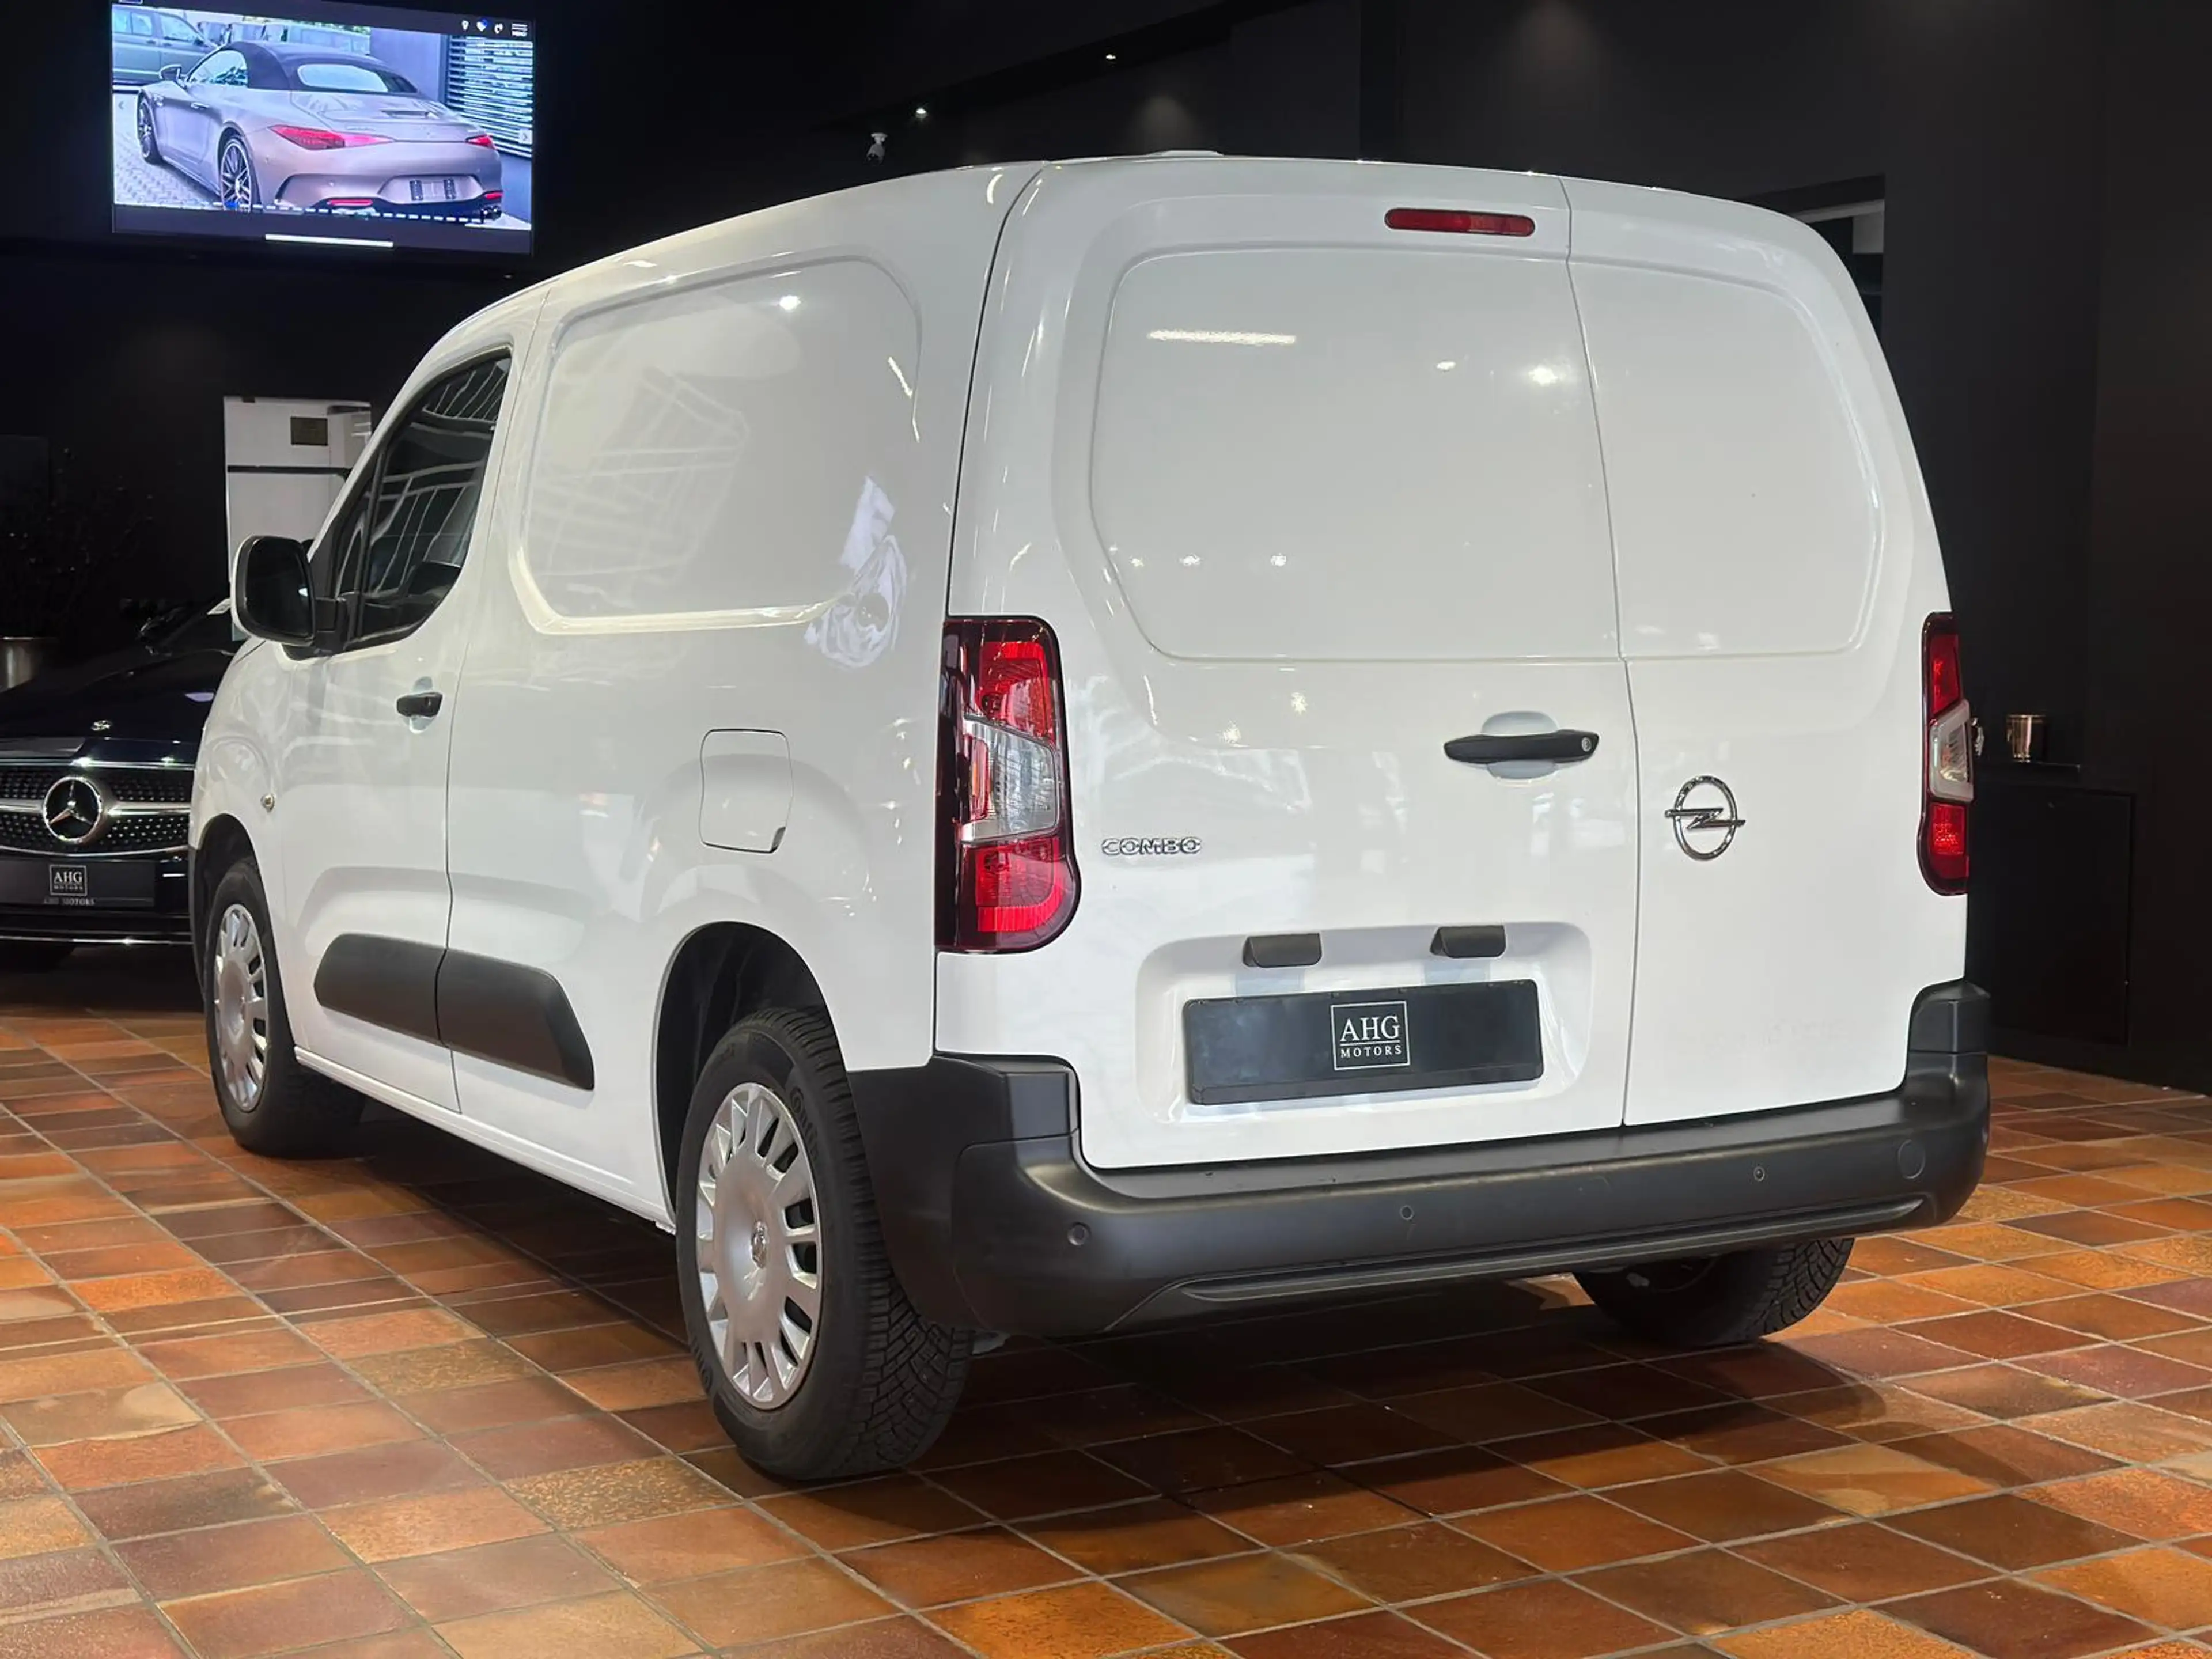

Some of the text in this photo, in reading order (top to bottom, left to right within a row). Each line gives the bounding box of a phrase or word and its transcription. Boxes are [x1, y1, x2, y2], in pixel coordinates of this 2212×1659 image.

[1101, 837, 1201, 855] COMBO
[54, 871, 83, 884] AHG
[1339, 1015, 1400, 1041] AHG
[1340, 1044, 1402, 1058] MOTORS
